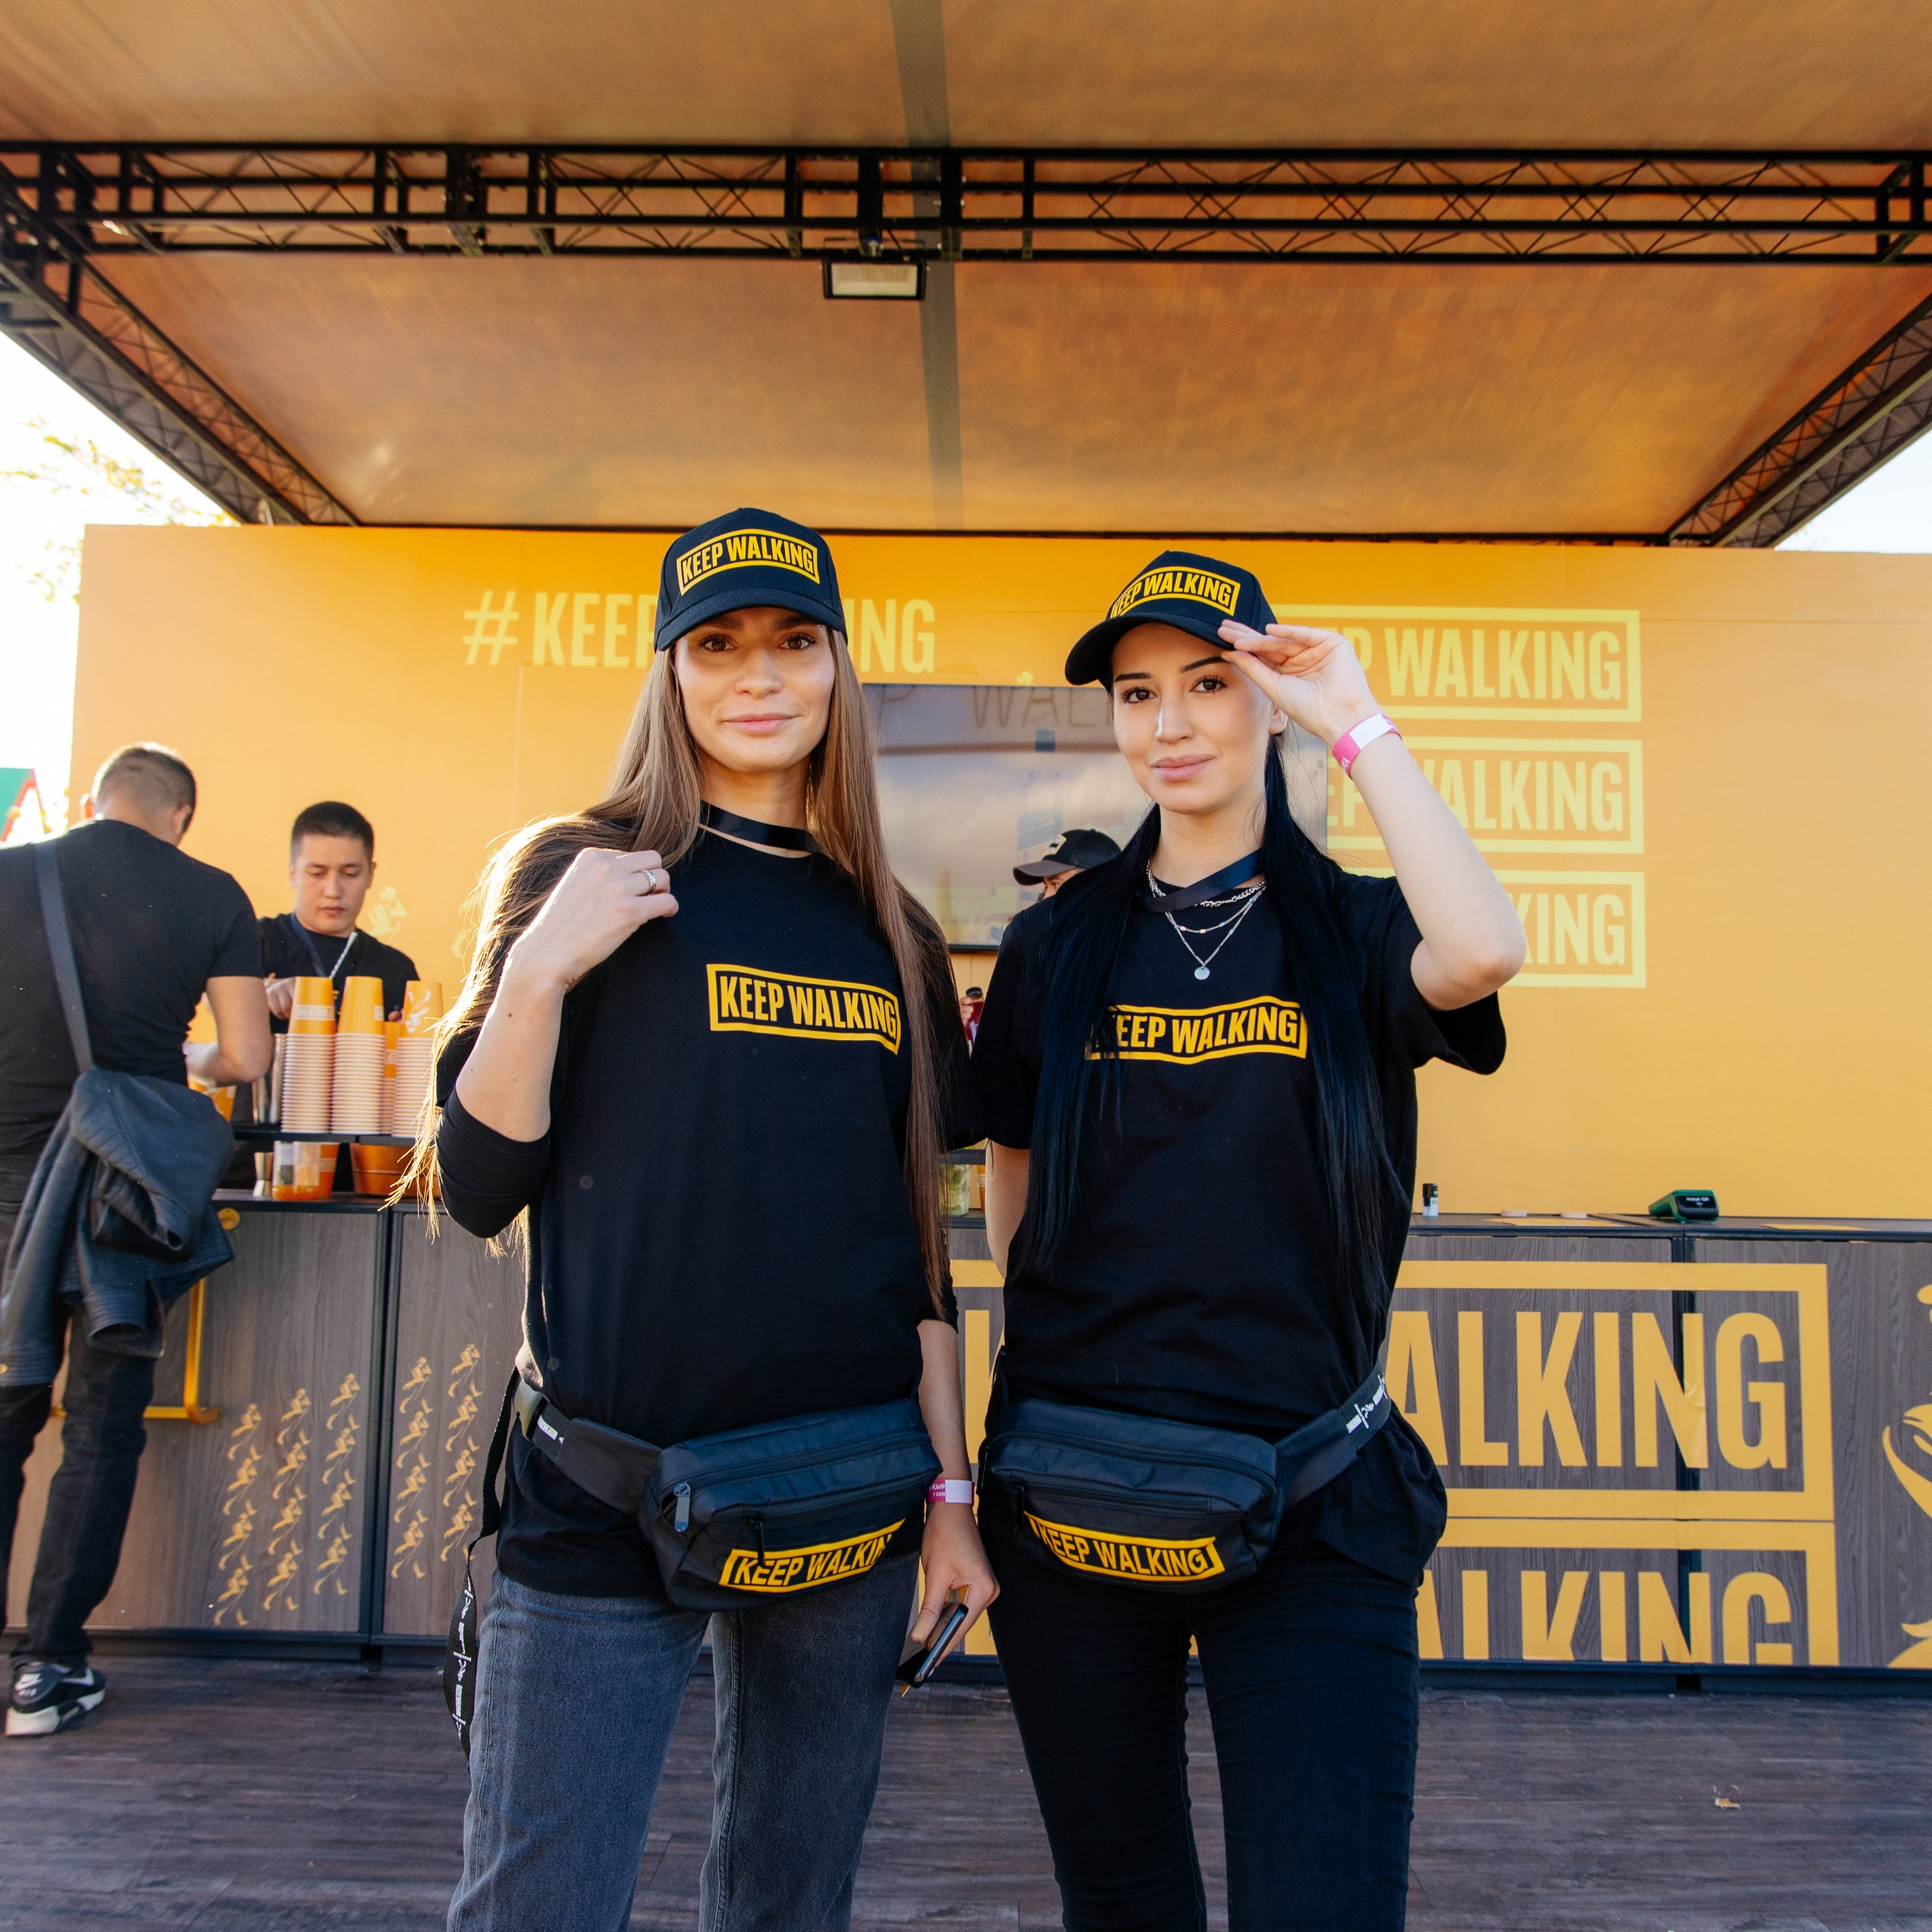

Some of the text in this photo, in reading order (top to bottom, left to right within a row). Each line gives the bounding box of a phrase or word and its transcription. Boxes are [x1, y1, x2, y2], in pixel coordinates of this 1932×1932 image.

[682, 536, 814, 584] KEEP WALKING
[1143, 572, 1232, 607] WALKING
[1384, 627, 1622, 700] WALKING
[1423, 758, 1623, 832] ALKING
[719, 976, 897, 1040] KEEP WALKING
[1112, 1006, 1298, 1054] EEP WALKING
[734, 1557, 804, 1586] KEEP
[1039, 1522, 1209, 1576] KEEP WALKING
